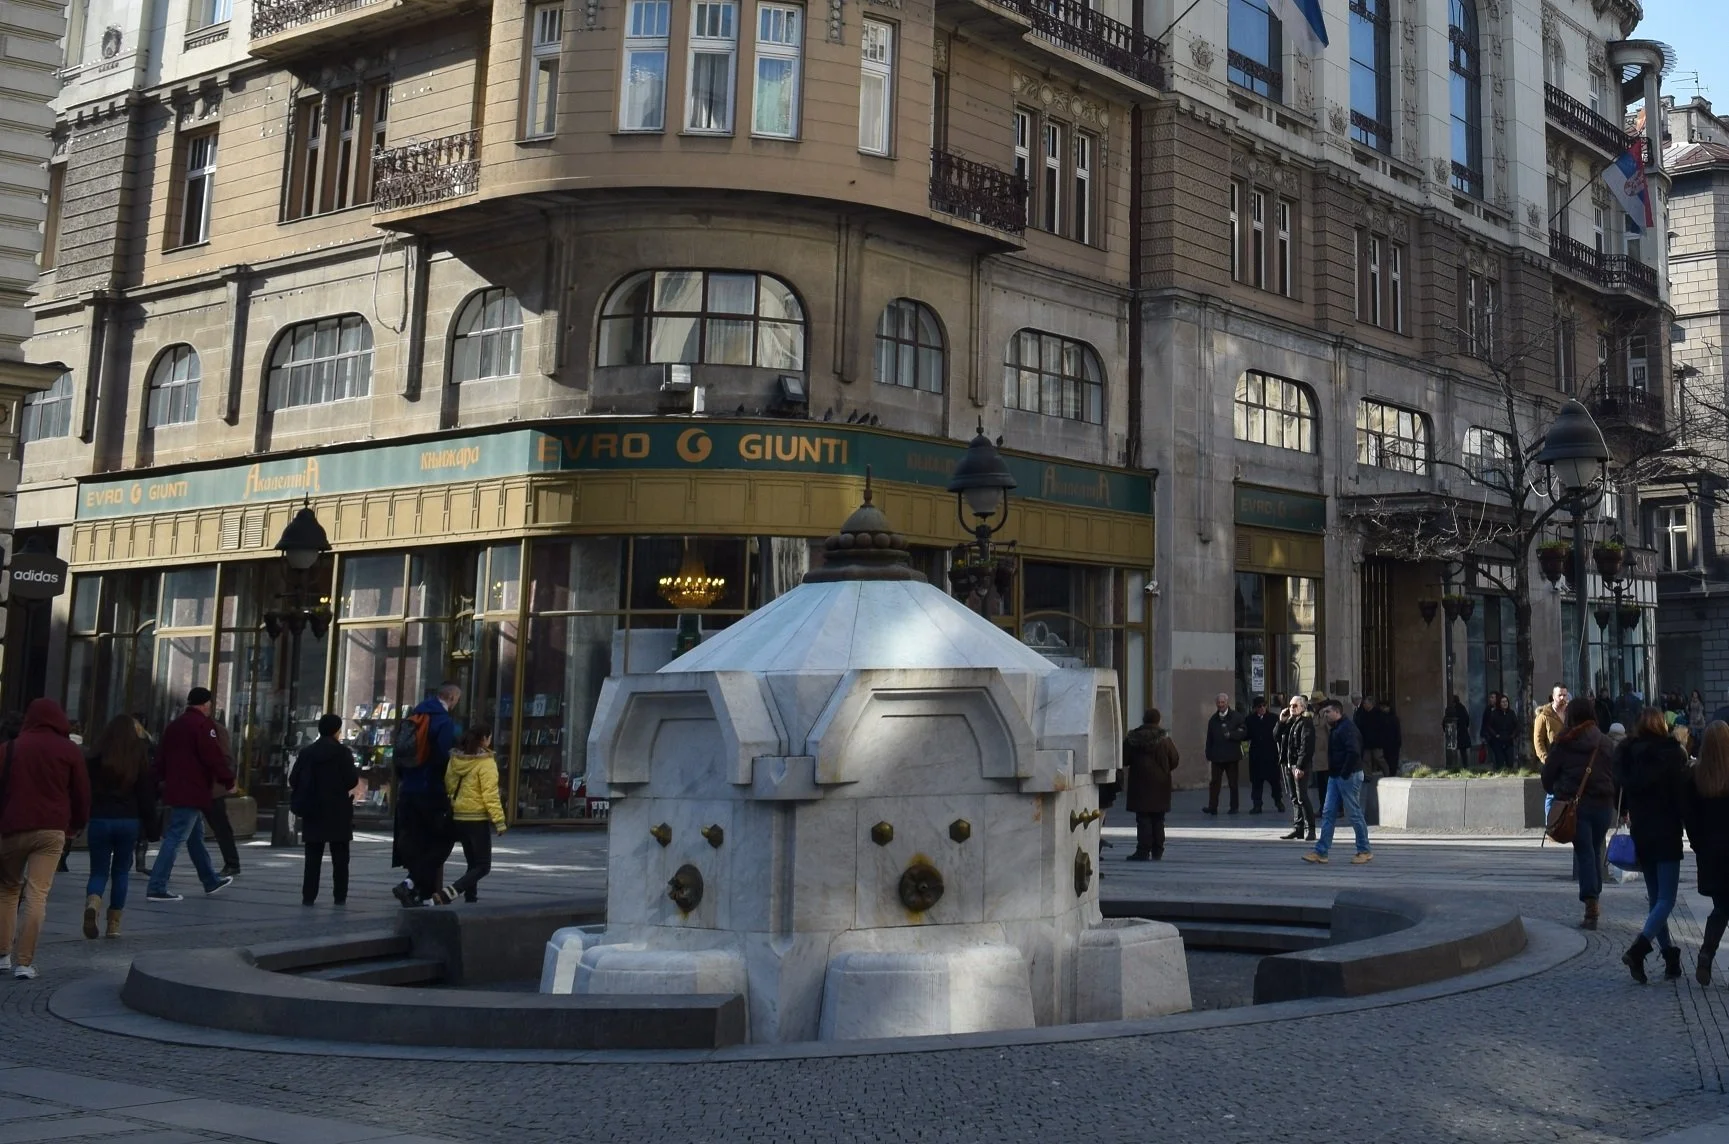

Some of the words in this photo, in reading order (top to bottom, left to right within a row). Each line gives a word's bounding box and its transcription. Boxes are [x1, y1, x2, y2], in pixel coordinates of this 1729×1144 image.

[537, 432, 651, 463] EVRO
[739, 432, 848, 465] GIUNTI
[86, 488, 124, 507] EVRO
[149, 481, 189, 501] GIUNTI
[13, 569, 59, 583] adidas
